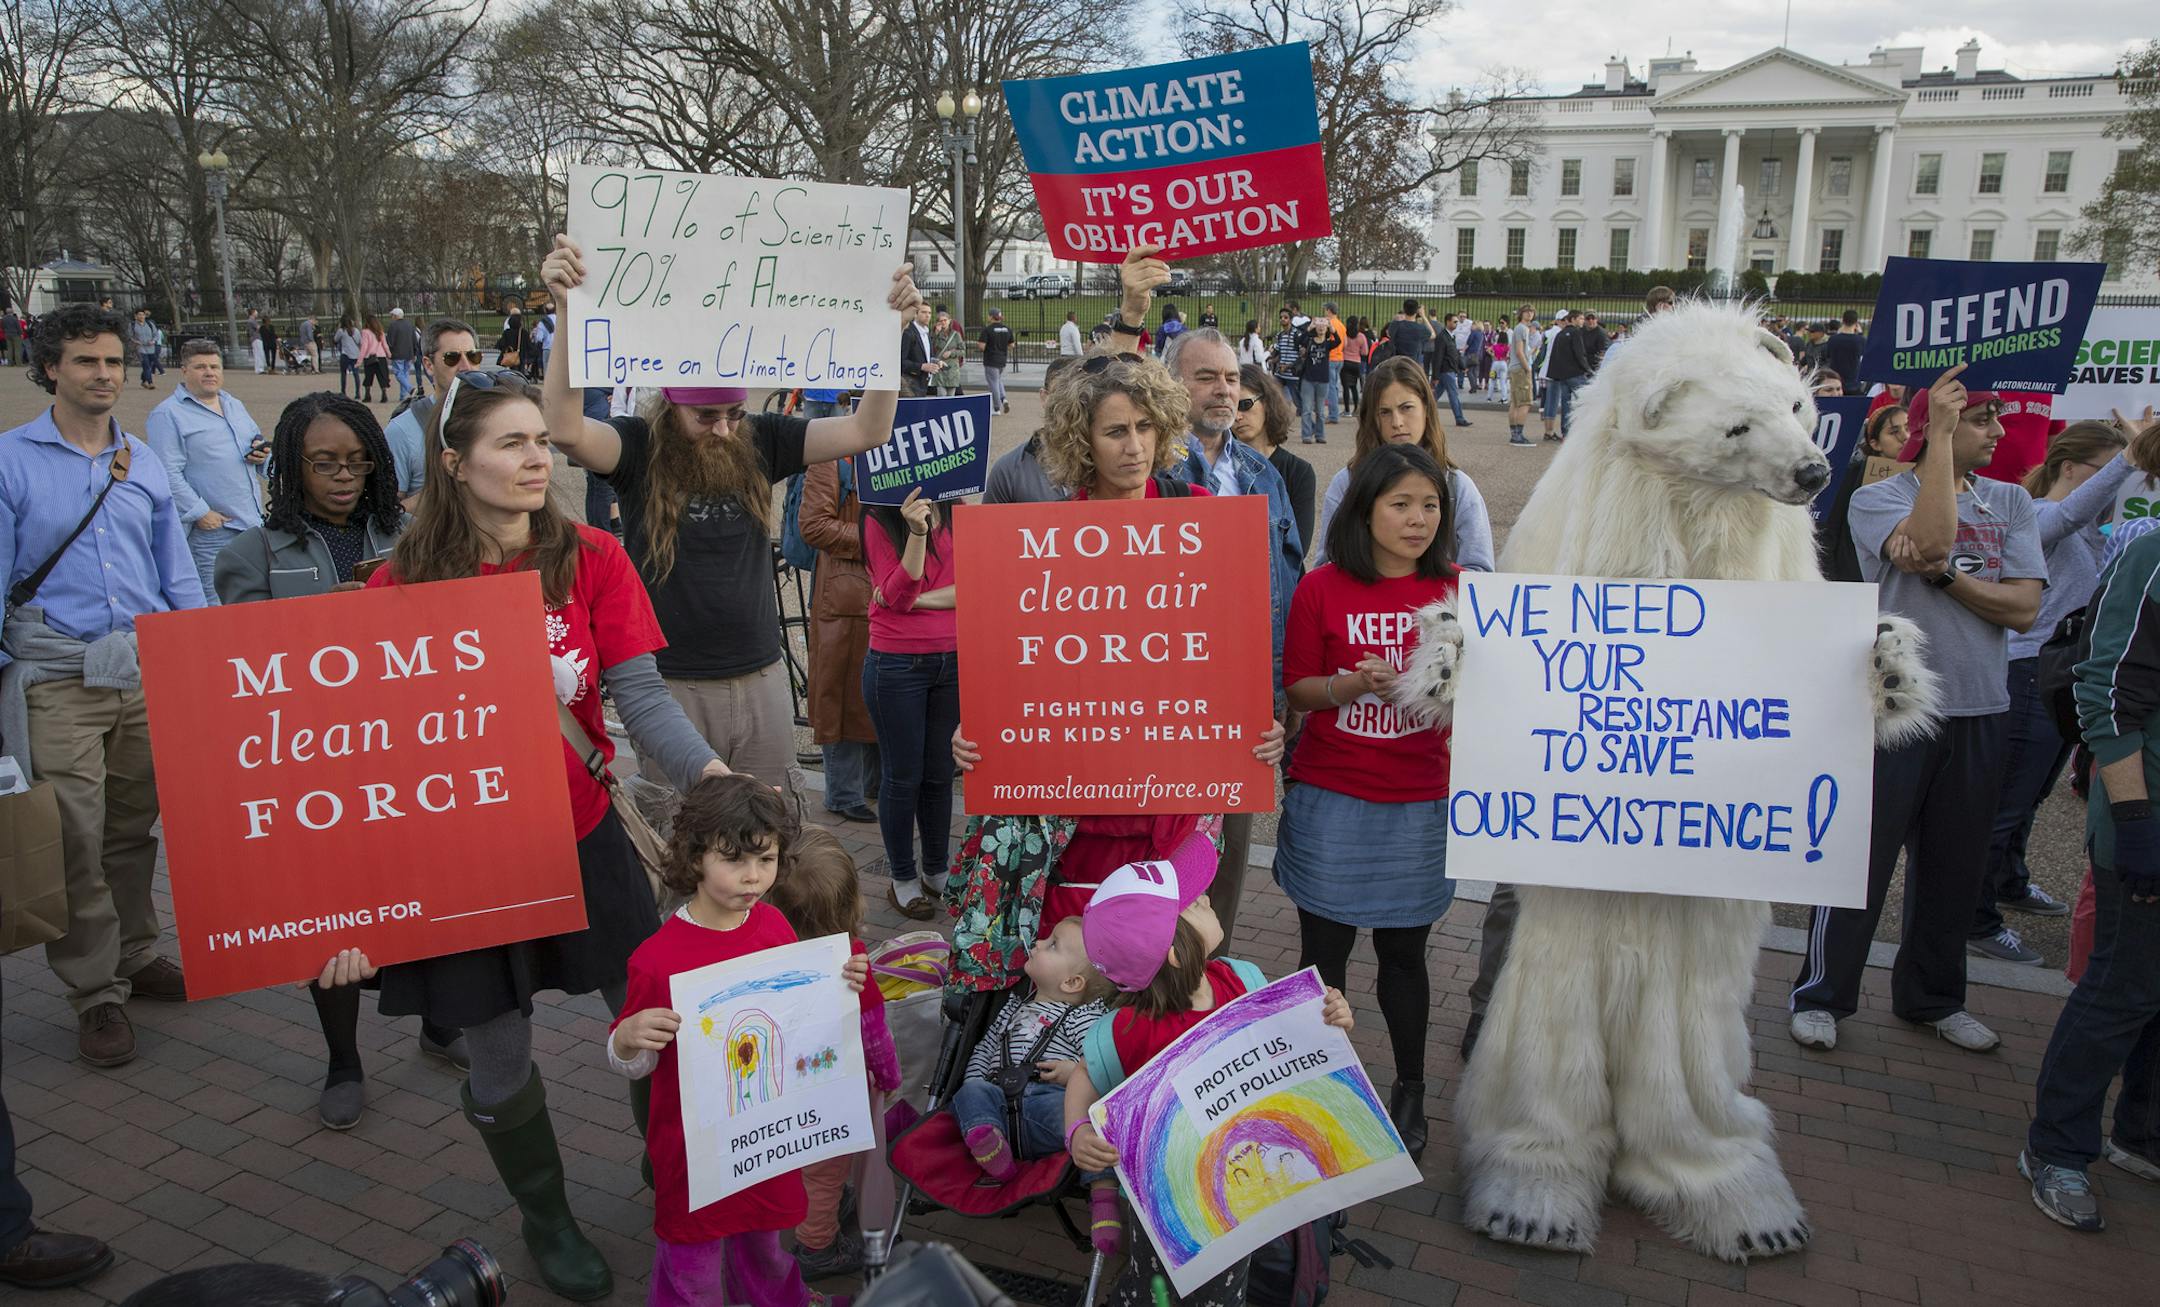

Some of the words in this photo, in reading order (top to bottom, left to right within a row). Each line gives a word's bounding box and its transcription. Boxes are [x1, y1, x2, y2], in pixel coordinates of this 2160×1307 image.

[1059, 69, 1246, 125] CLIMATE
[1074, 113, 1248, 164] ACTION:
[590, 173, 702, 240] 97%
[719, 190, 760, 244] of
[759, 187, 893, 250] Scientists,
[1080, 183, 1155, 217] IT'S
[1165, 169, 1258, 210] OUR
[1063, 199, 1300, 254] OBLIGATION
[596, 247, 677, 309] 70%
[702, 260, 737, 311] of
[750, 255, 864, 313] Americans,
[1895, 278, 2070, 349] DEFEND
[584, 318, 664, 384] Agree
[678, 359, 701, 376] on
[716, 322, 796, 382] Climate
[804, 328, 884, 388] Change.
[1892, 347, 1966, 370] CLIMATE
[1971, 327, 2061, 363] PROGRESS
[1991, 380, 2057, 392] #ACTONCLIMATE
[2067, 366, 2145, 385] SAVES
[864, 409, 976, 474] DEFEND
[870, 468, 914, 492] CLIMATE
[915, 446, 976, 481] PROGRESS
[1017, 521, 1204, 560] MOMS
[1018, 569, 1128, 614] clean
[1145, 571, 1208, 610] air
[1468, 583, 1552, 638] WE
[1571, 583, 1706, 637] NEED
[1016, 631, 1211, 665] FORCE
[1346, 612, 1413, 646] KEEP
[227, 628, 487, 699] MOMS
[1385, 646, 1403, 672] IN
[1531, 639, 1646, 692] YOUR
[237, 709, 394, 770] clean
[416, 693, 498, 746] air
[1023, 700, 1145, 717] FIGHTING
[1157, 699, 1208, 715] FOR
[1578, 693, 1791, 740] RESISTANCE
[1000, 727, 1051, 744] OUR
[1064, 726, 1132, 743] KIDS'
[1144, 724, 1243, 741] HEALTH
[1530, 728, 1588, 773] TO
[1596, 734, 1695, 776] SAVE
[239, 765, 509, 840] FORCE
[993, 773, 1243, 808] momscleanairforce.org
[1449, 790, 1541, 842] OUR
[208, 930, 242, 952] I'M
[247, 908, 374, 945] MARCHING
[378, 901, 423, 924] FOR
[1193, 1047, 1263, 1101] PROTECT
[1264, 1036, 1294, 1058] US,
[1204, 1092, 1239, 1122] NOT
[1241, 1048, 1330, 1099] POLLUTERS
[730, 1116, 793, 1153] PROTECT
[796, 1109, 822, 1128] US,
[733, 1152, 763, 1178] NOT
[766, 1124, 851, 1164] POLLUTERS
